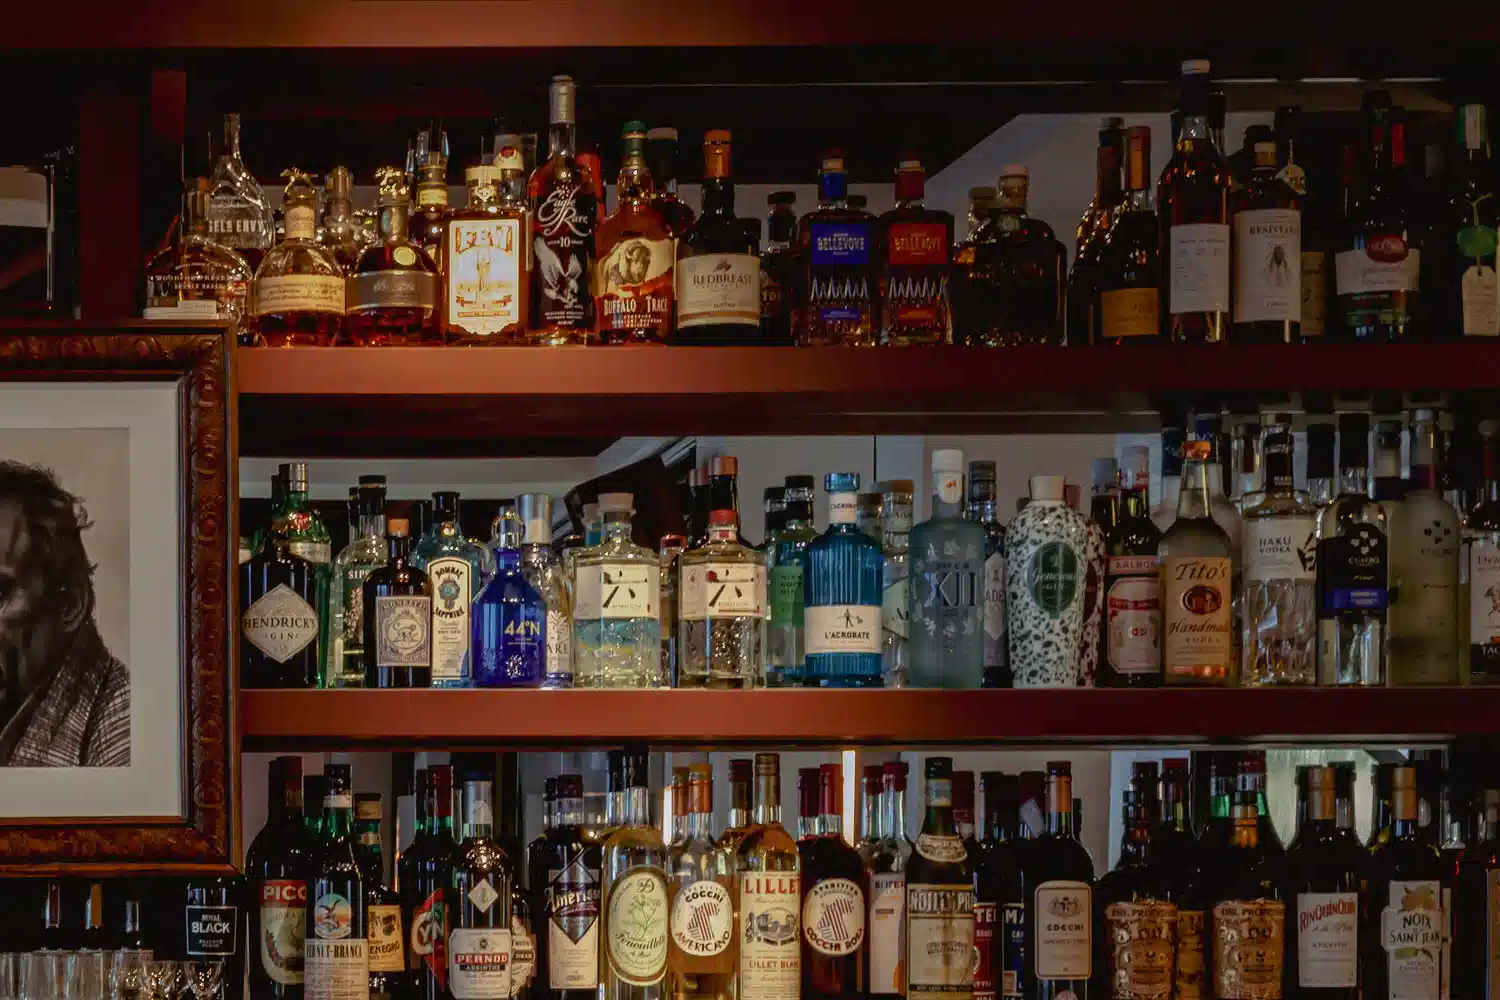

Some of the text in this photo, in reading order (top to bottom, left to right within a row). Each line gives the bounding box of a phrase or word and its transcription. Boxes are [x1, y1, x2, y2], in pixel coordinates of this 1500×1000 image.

[560, 237, 571, 248] 10
[692, 273, 752, 286] REDBREAST
[603, 298, 637, 316] BUFFALO
[646, 296, 669, 313] TRACE
[1258, 537, 1291, 547] HAKU
[1258, 547, 1291, 556] VODKA
[435, 565, 463, 578] BOMBAY
[1175, 562, 1228, 580] Tito's
[243, 617, 317, 630] HENDRICK'S
[269, 632, 293, 640] GIN
[824, 631, 871, 641] L'ACROBATE
[684, 890, 725, 904] COCCHI
[1403, 912, 1431, 929] NOIX
[191, 921, 231, 935] BLACK
[1046, 923, 1084, 932] COCCHI
[674, 930, 731, 954] AMERICANO
[806, 927, 841, 952] COCCHI
[1390, 930, 1441, 945] SAINT JEAN
[455, 953, 508, 965] PERNOD
[749, 960, 777, 969] LILLET
